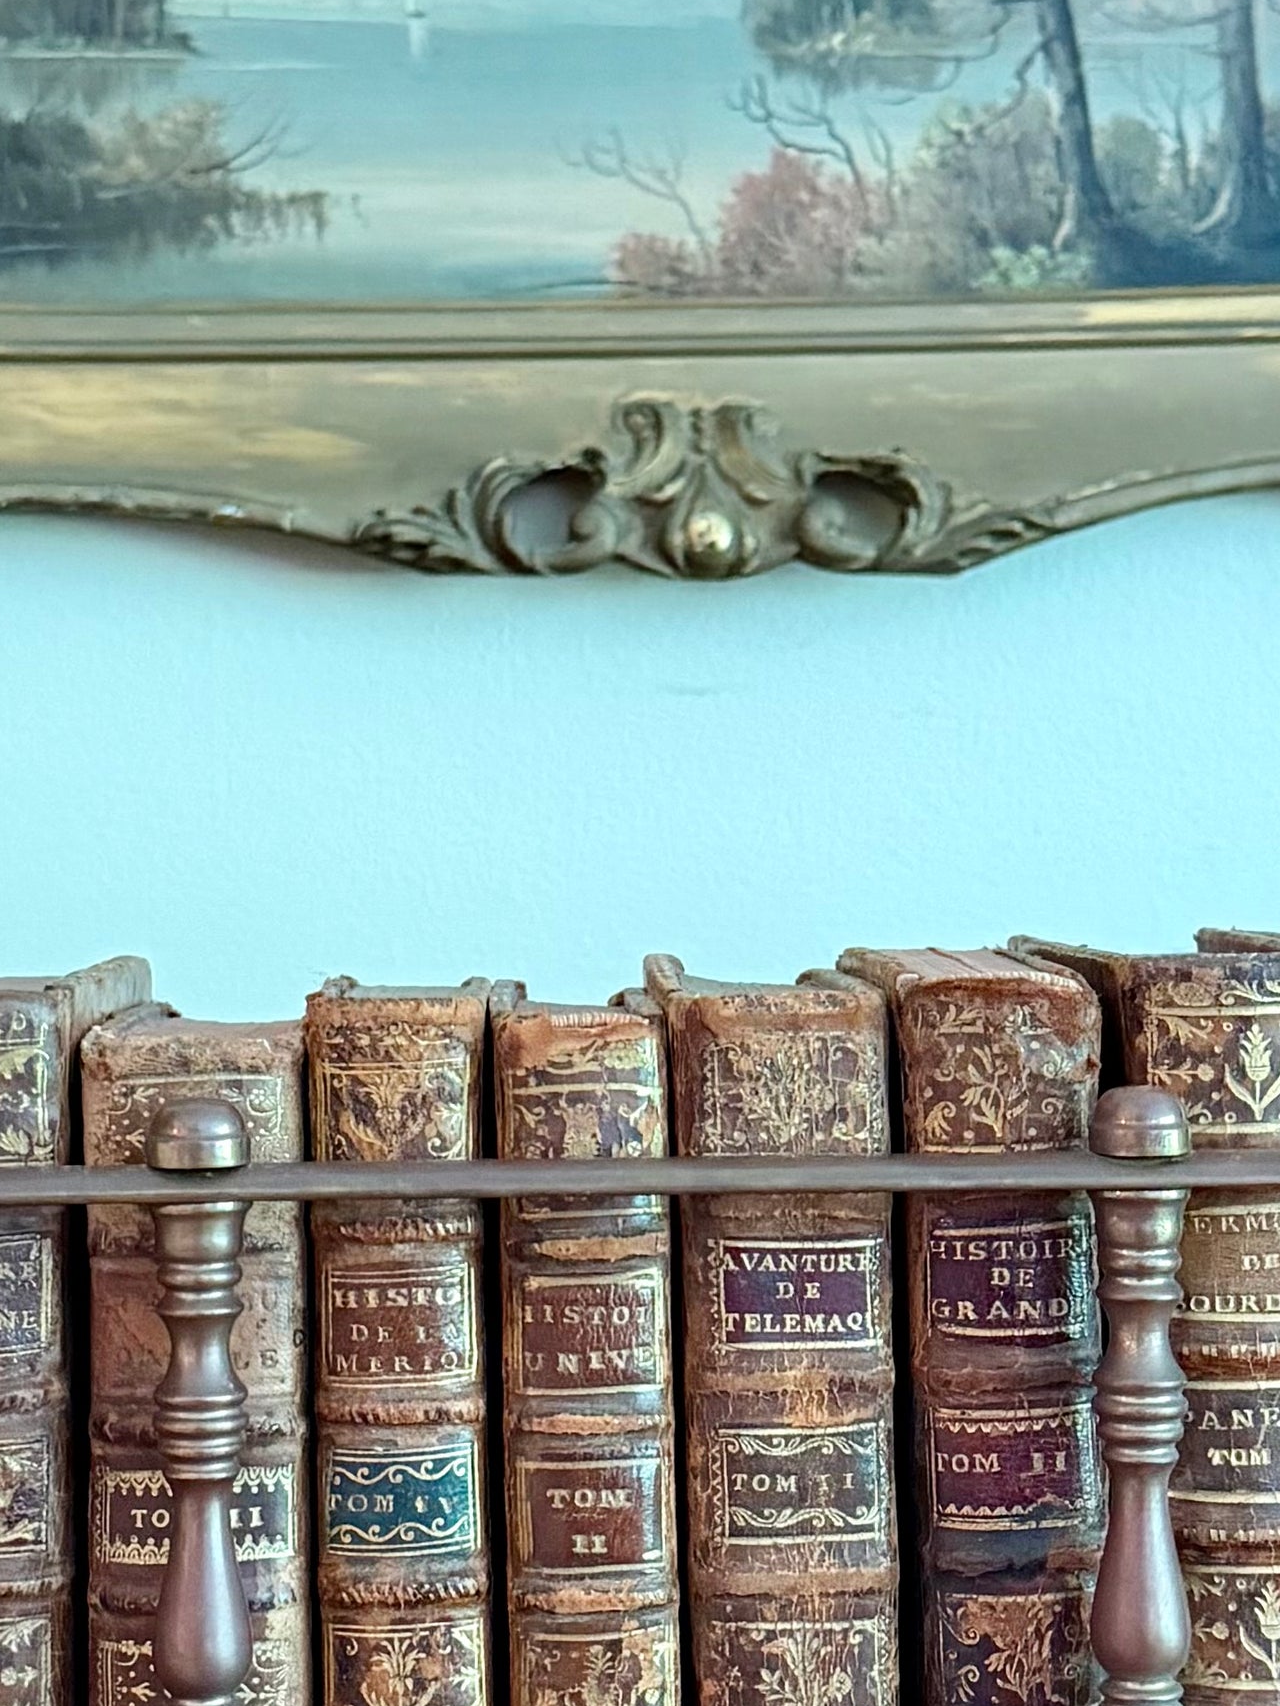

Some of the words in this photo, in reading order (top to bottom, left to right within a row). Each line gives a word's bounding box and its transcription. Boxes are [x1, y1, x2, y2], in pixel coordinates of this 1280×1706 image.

[1241, 1253, 1280, 1271] DE
[990, 1267, 1035, 1288] DE
[334, 1286, 461, 1308] HISTO
[776, 1282, 821, 1299] DE
[351, 1324, 393, 1342] DE
[336, 1351, 458, 1372] MERIQ
[936, 1452, 1001, 1473] TOM
[1207, 1447, 1271, 1467] TOM
[731, 1473, 798, 1492] TOM
[329, 1494, 394, 1513] TOM
[547, 1489, 634, 1508] TOM
[131, 1509, 170, 1528] TO
[572, 1534, 608, 1554] II
